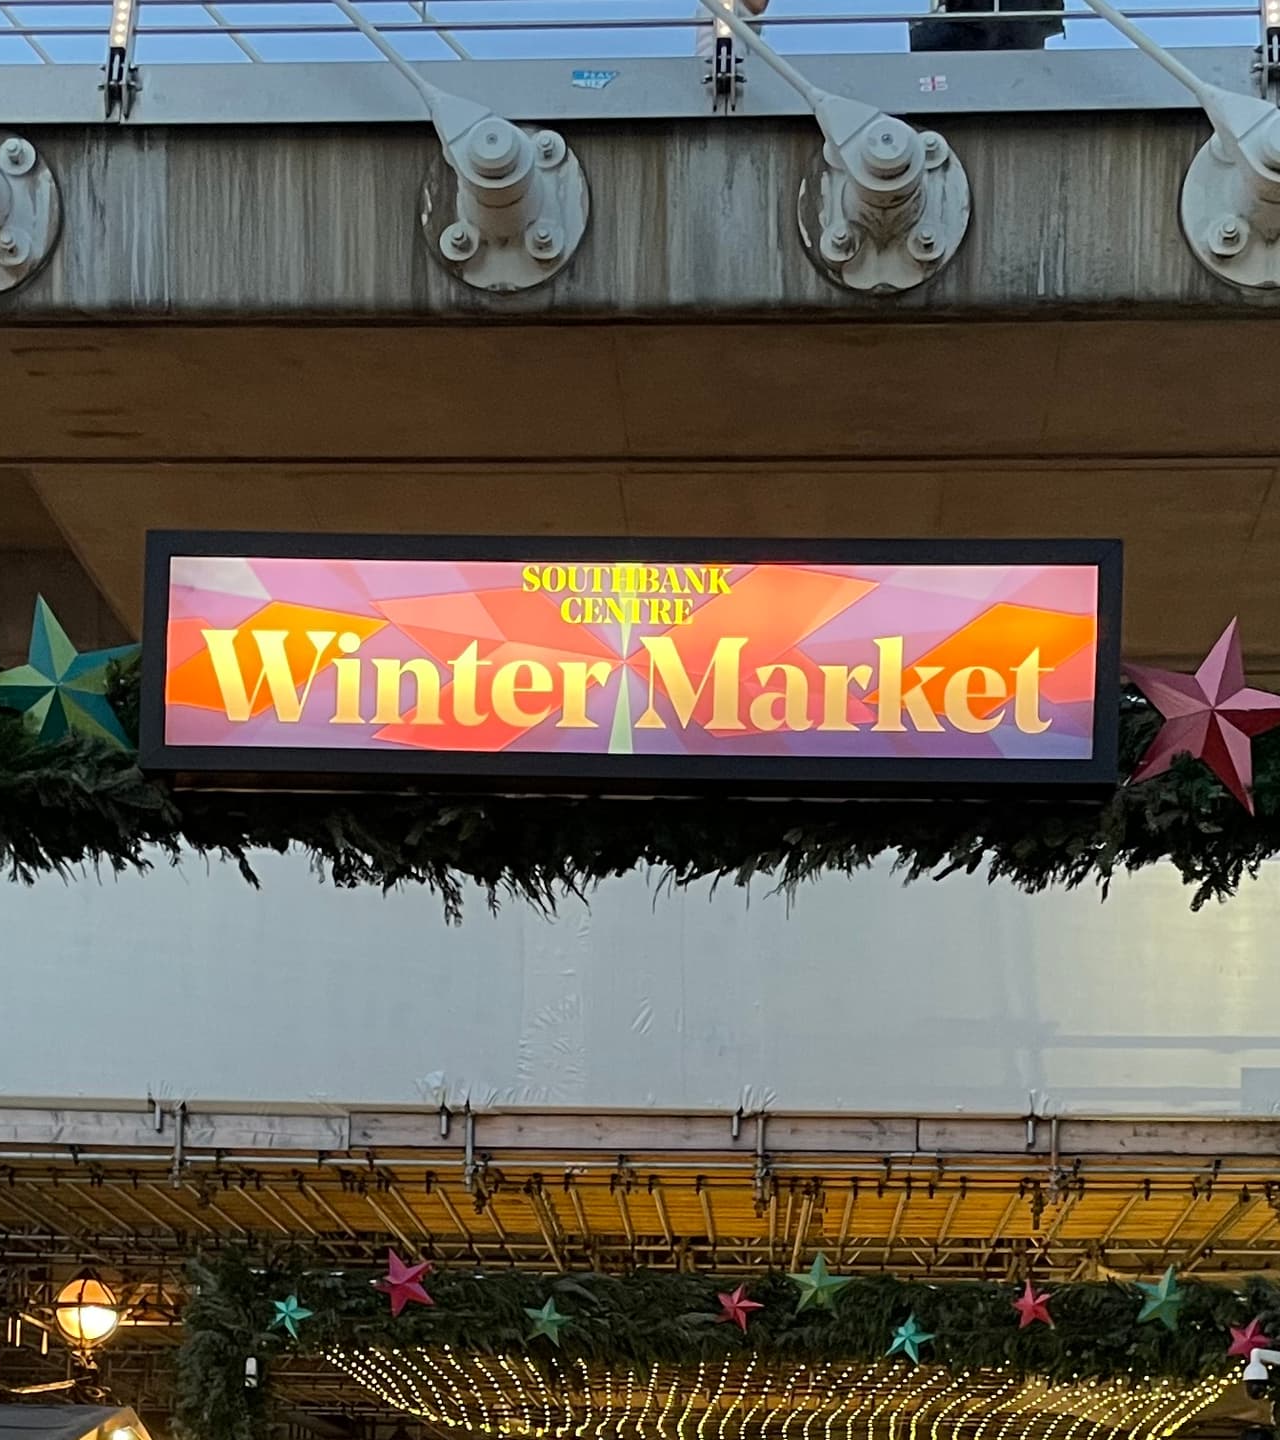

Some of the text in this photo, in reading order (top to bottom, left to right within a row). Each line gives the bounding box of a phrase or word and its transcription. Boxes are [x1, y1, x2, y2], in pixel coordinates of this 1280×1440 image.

[521, 565, 733, 595] SOUTHBANK
[560, 596, 693, 625] CENTRE
[200, 627, 1056, 736] Winter Market
